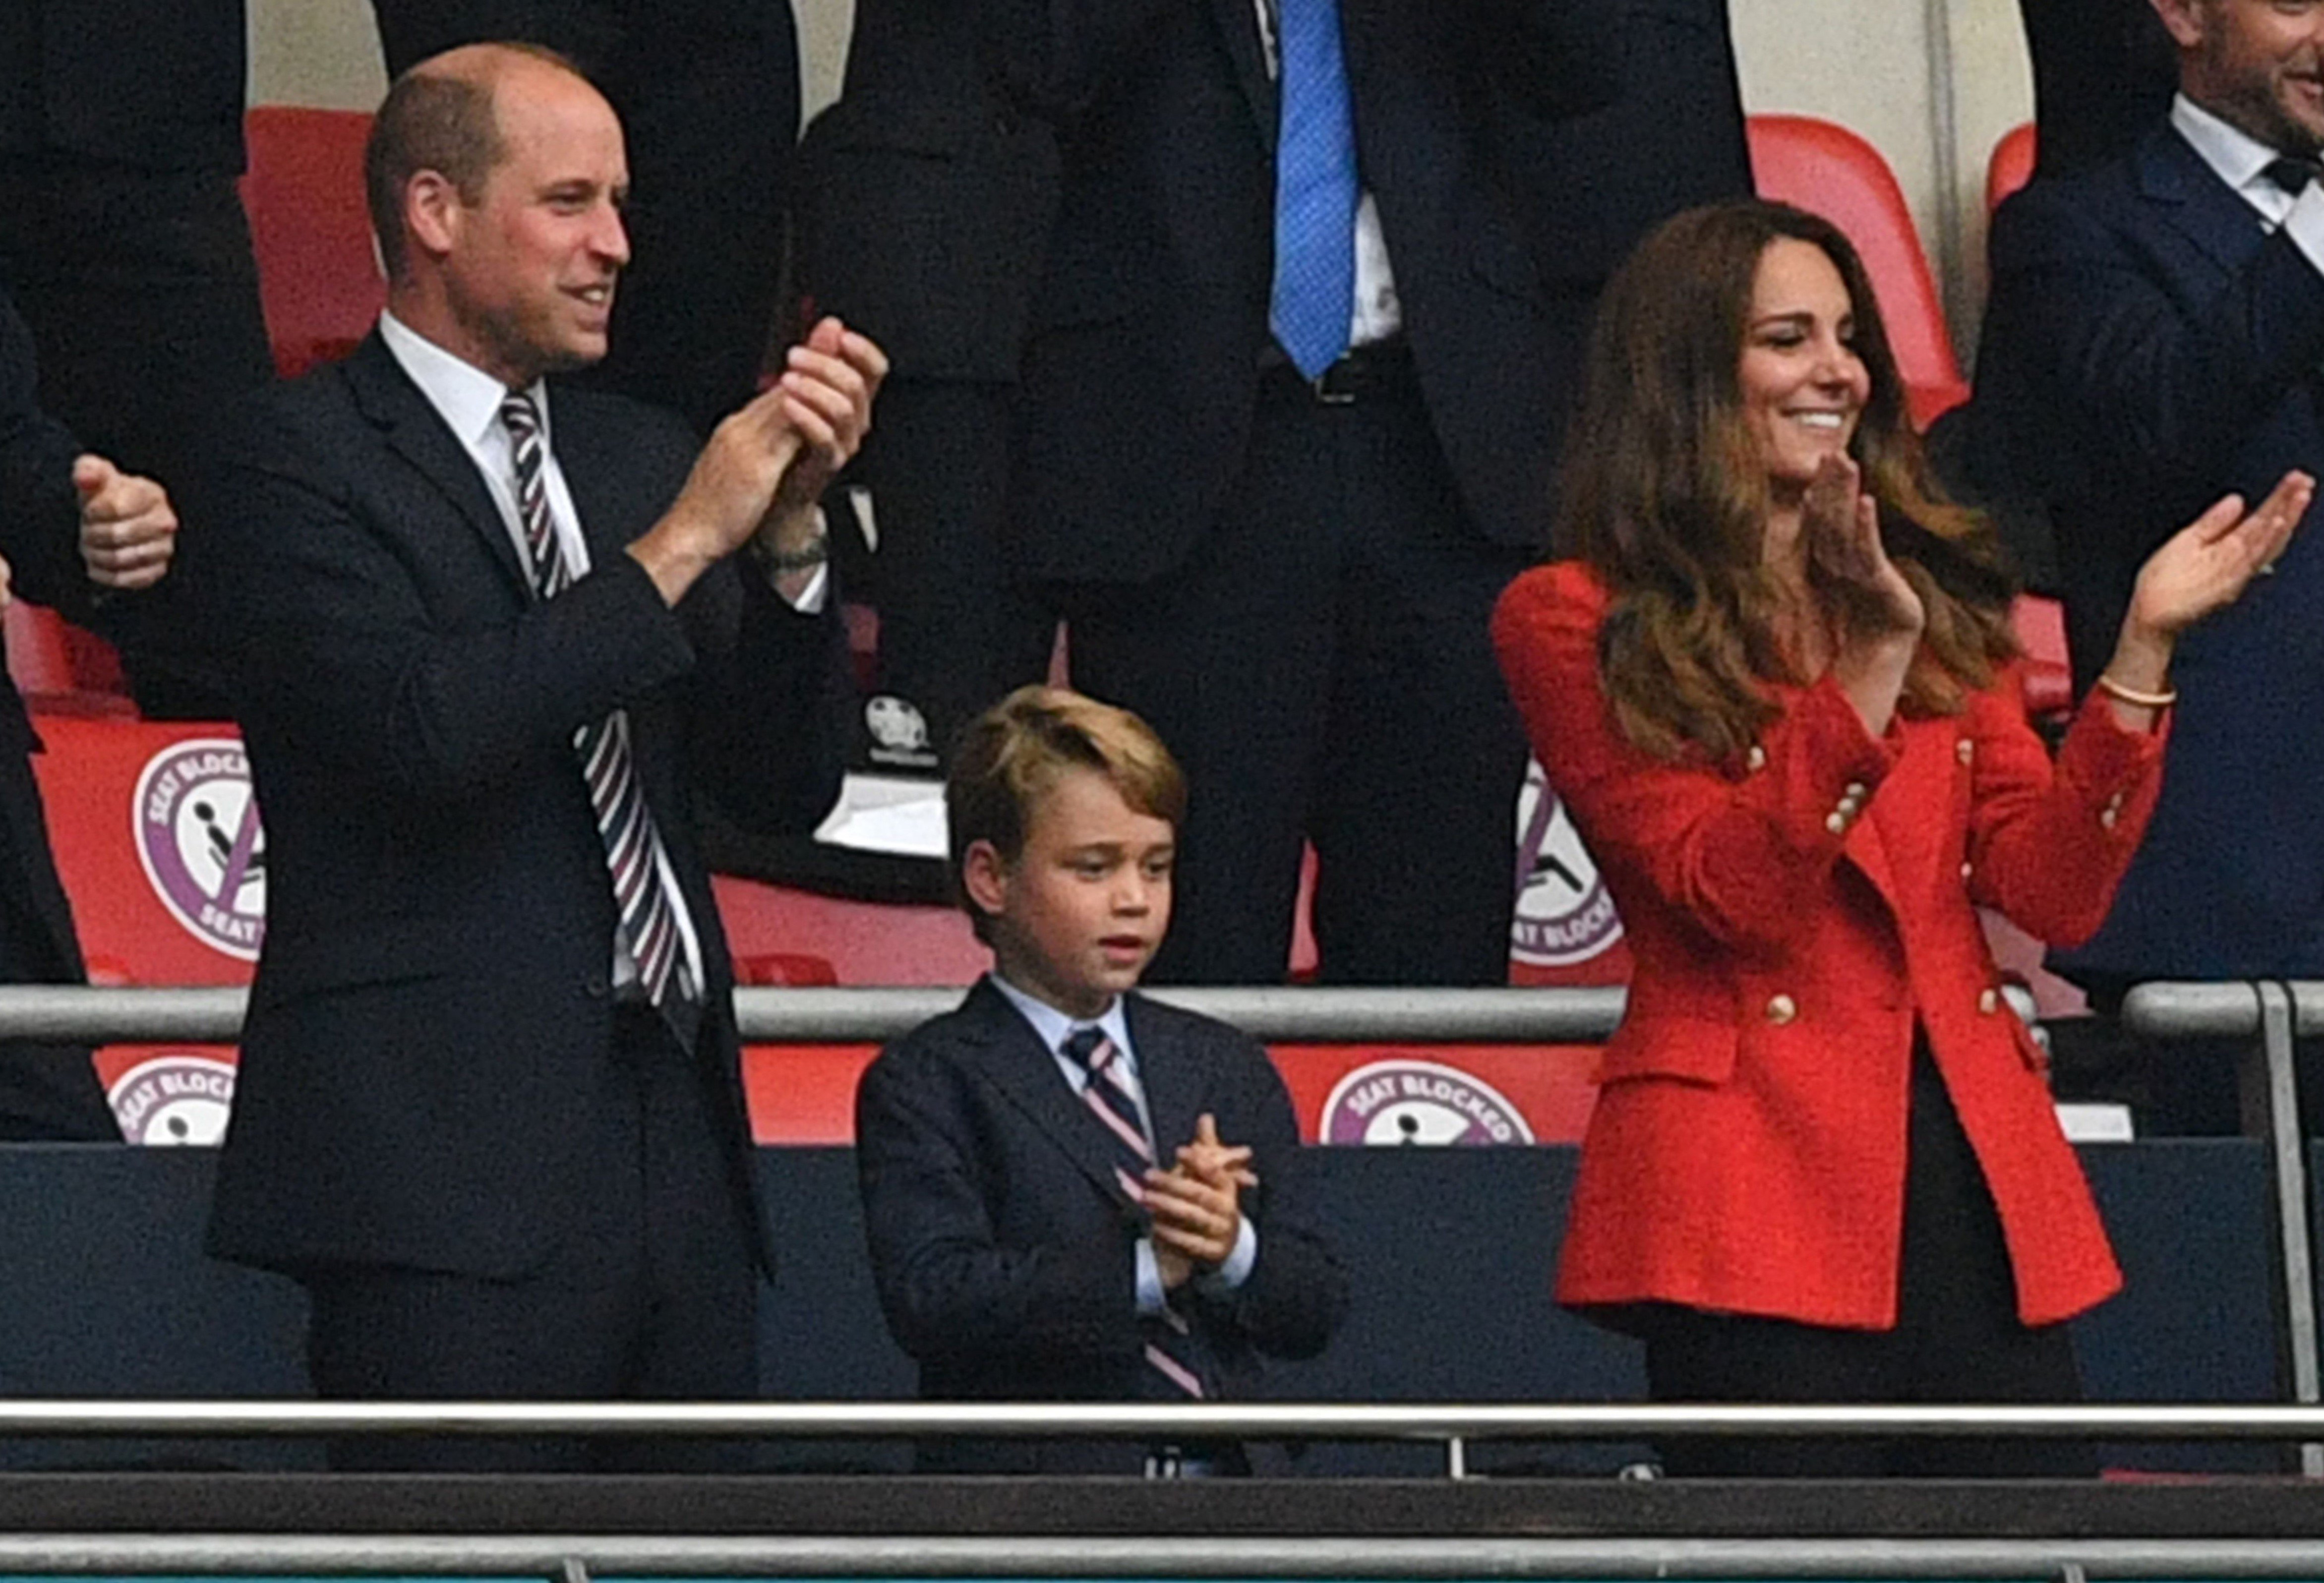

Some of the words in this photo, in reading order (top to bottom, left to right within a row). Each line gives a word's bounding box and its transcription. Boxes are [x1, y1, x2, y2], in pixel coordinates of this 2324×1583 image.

[148, 769, 180, 826] SEAT
[200, 903, 256, 941] SEAT
[1347, 1077, 1397, 1116] SEAT
[1400, 1075, 1512, 1142] BLOCKED
